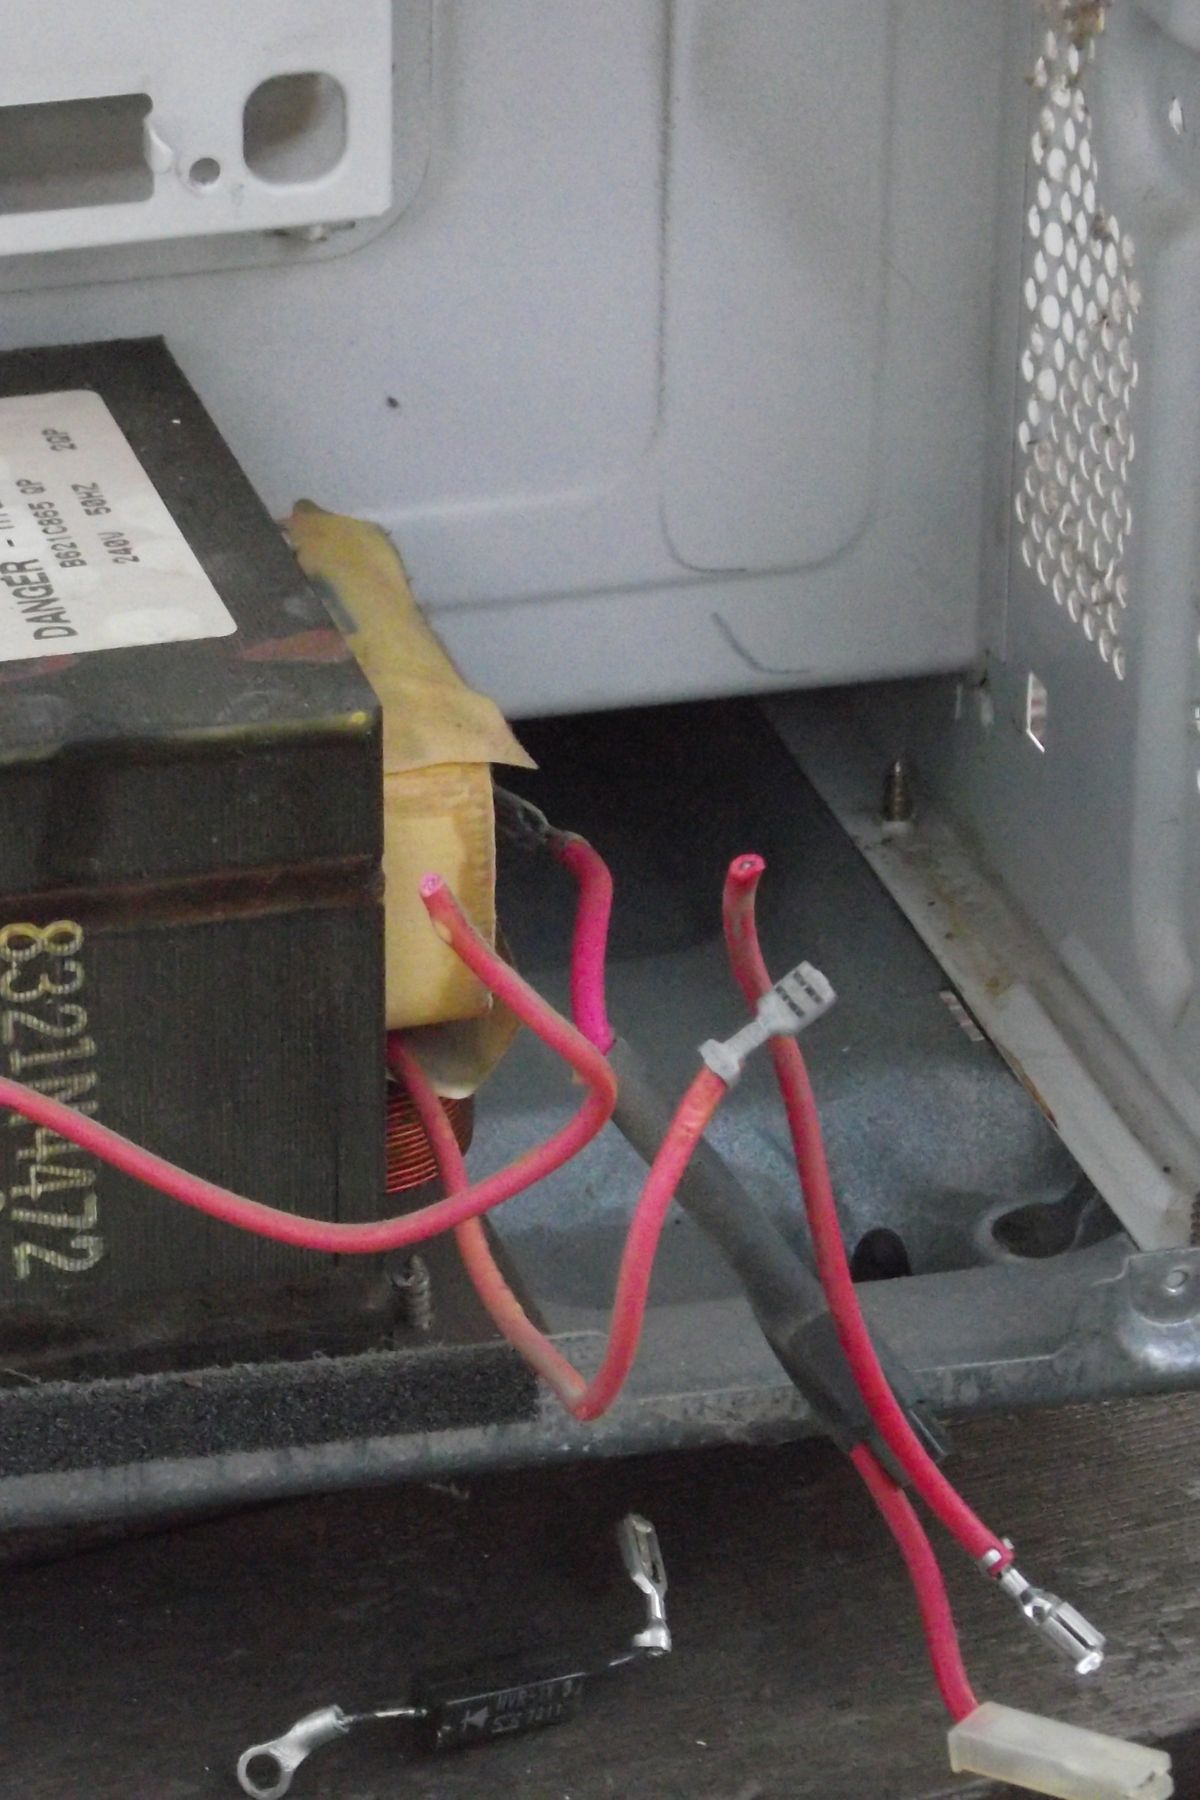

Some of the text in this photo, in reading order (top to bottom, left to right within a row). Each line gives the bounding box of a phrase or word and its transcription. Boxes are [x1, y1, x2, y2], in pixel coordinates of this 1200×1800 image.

[71, 482, 111, 516] 50HZ
[27, 501, 88, 568] B621C865
[97, 531, 140, 564] 240V
[0, 559, 78, 640] DANGER
